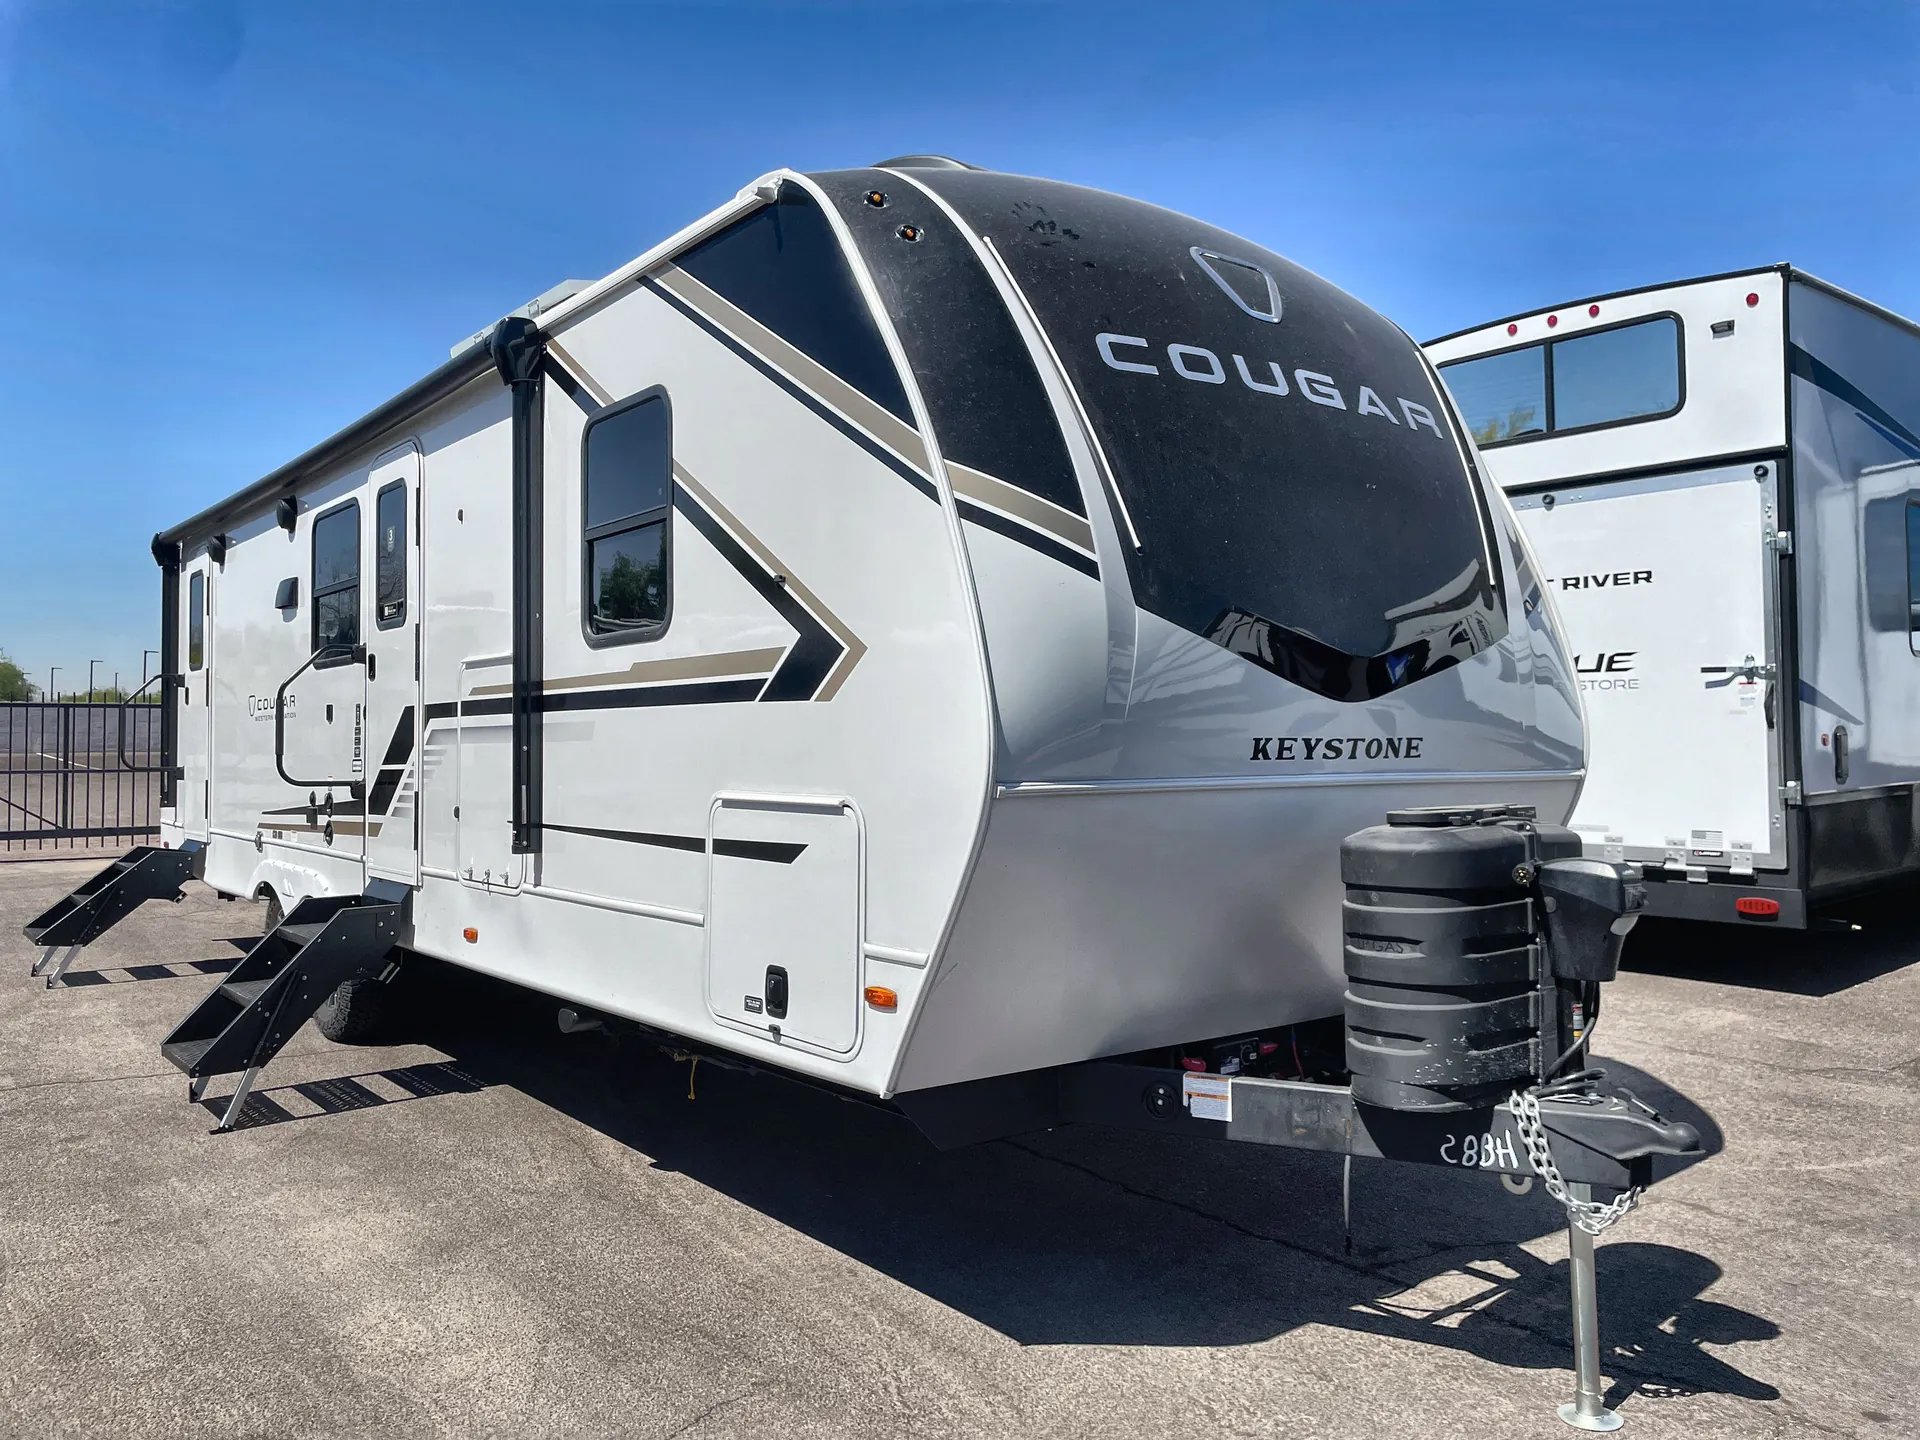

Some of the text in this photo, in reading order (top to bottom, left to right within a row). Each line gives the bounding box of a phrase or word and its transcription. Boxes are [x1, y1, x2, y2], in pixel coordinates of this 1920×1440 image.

[1095, 332, 1443, 439] COUGAR
[1561, 570, 1653, 591] RIVER
[257, 694, 296, 711] COUAR
[1250, 737, 1423, 761] KEYSTONE
